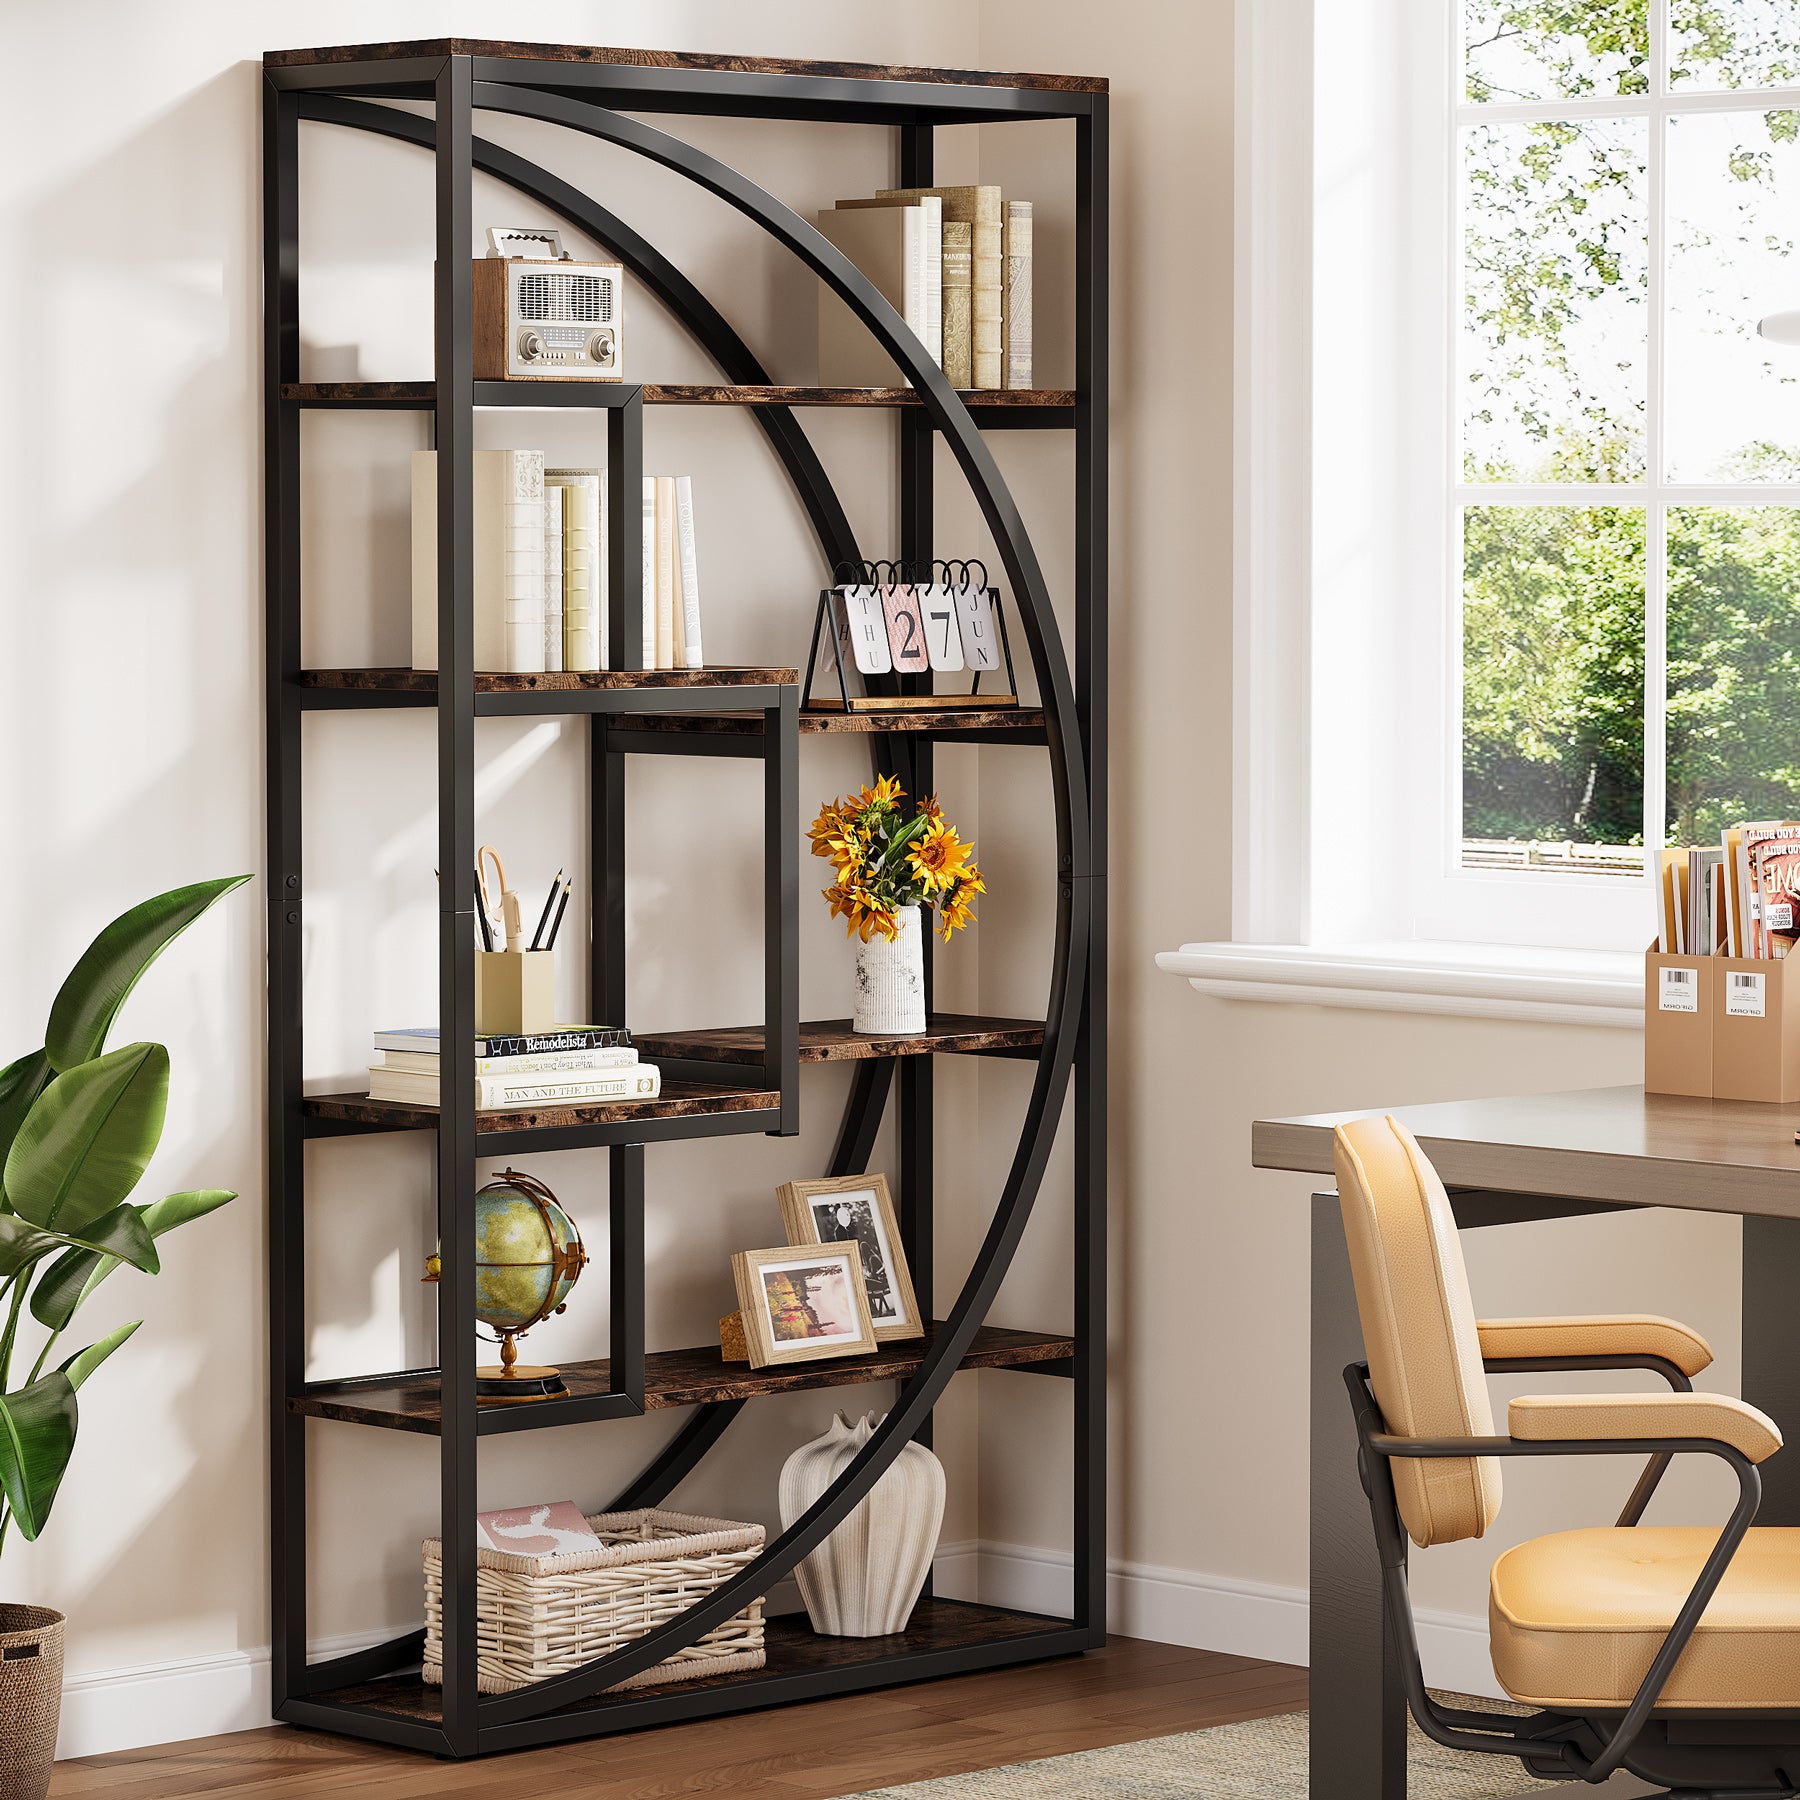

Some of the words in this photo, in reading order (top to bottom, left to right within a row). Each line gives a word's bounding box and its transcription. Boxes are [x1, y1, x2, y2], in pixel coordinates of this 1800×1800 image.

[680, 499, 692, 547] YOUNG
[684, 560, 696, 585] THE
[686, 588, 699, 631] SHACK
[969, 594, 989, 665] JUN
[858, 597, 879, 669] THU
[526, 1033, 588, 1051] Remodelista
[504, 1089, 530, 1101] MAN
[530, 1086, 556, 1099] AND
[559, 1084, 583, 1096] THE
[585, 1082, 628, 1094] FUTURE
